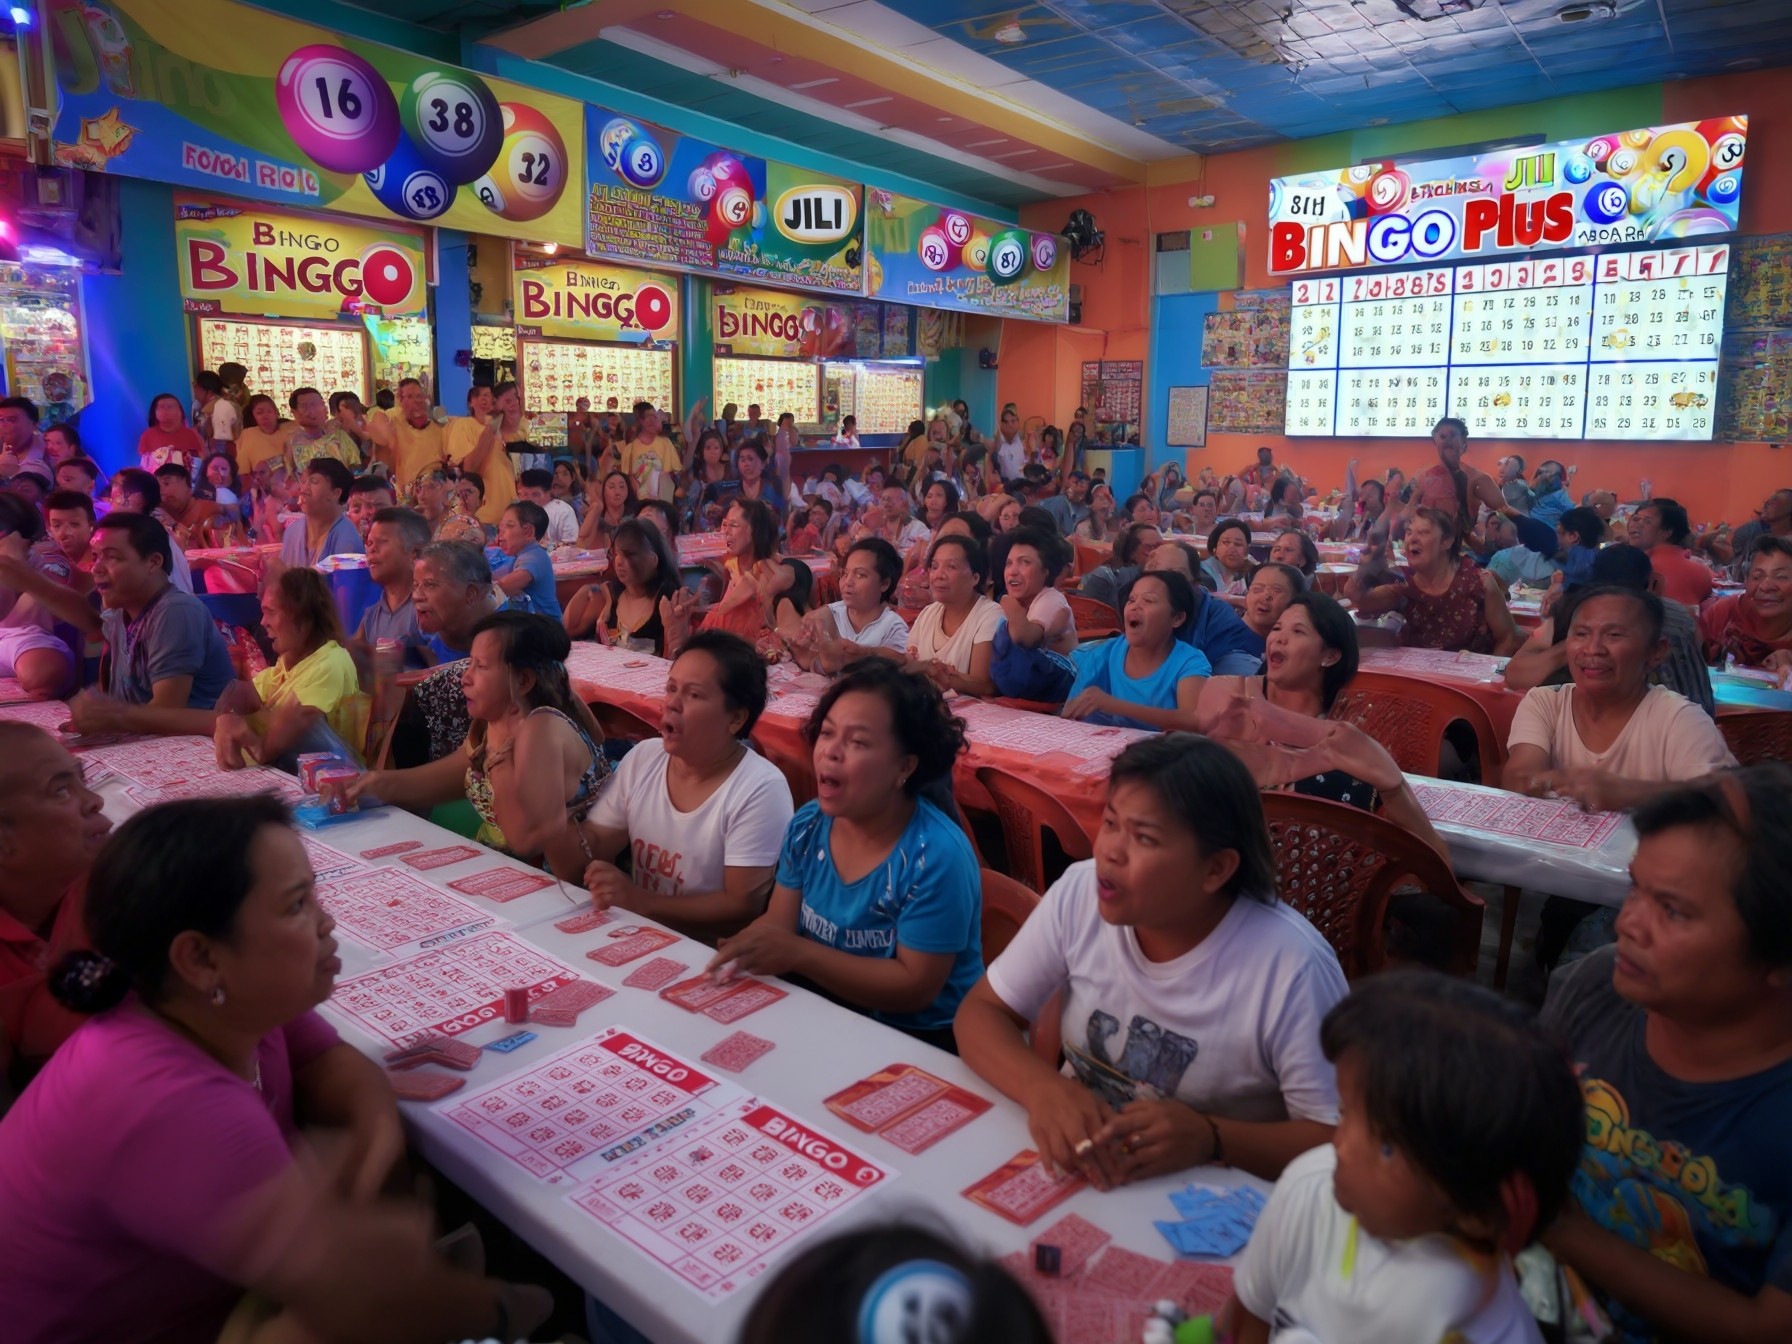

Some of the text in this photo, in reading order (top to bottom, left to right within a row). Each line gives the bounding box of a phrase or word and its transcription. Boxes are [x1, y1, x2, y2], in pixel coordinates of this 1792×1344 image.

[316, 77, 362, 120] 16
[428, 98, 474, 138] 38
[518, 152, 550, 186] 32
[784, 198, 842, 230] JILI
[253, 221, 339, 252] BINGO
[1272, 209, 1456, 271] BINGO
[1298, 283, 1309, 303] 2
[760, 1116, 848, 1169] BINGO
